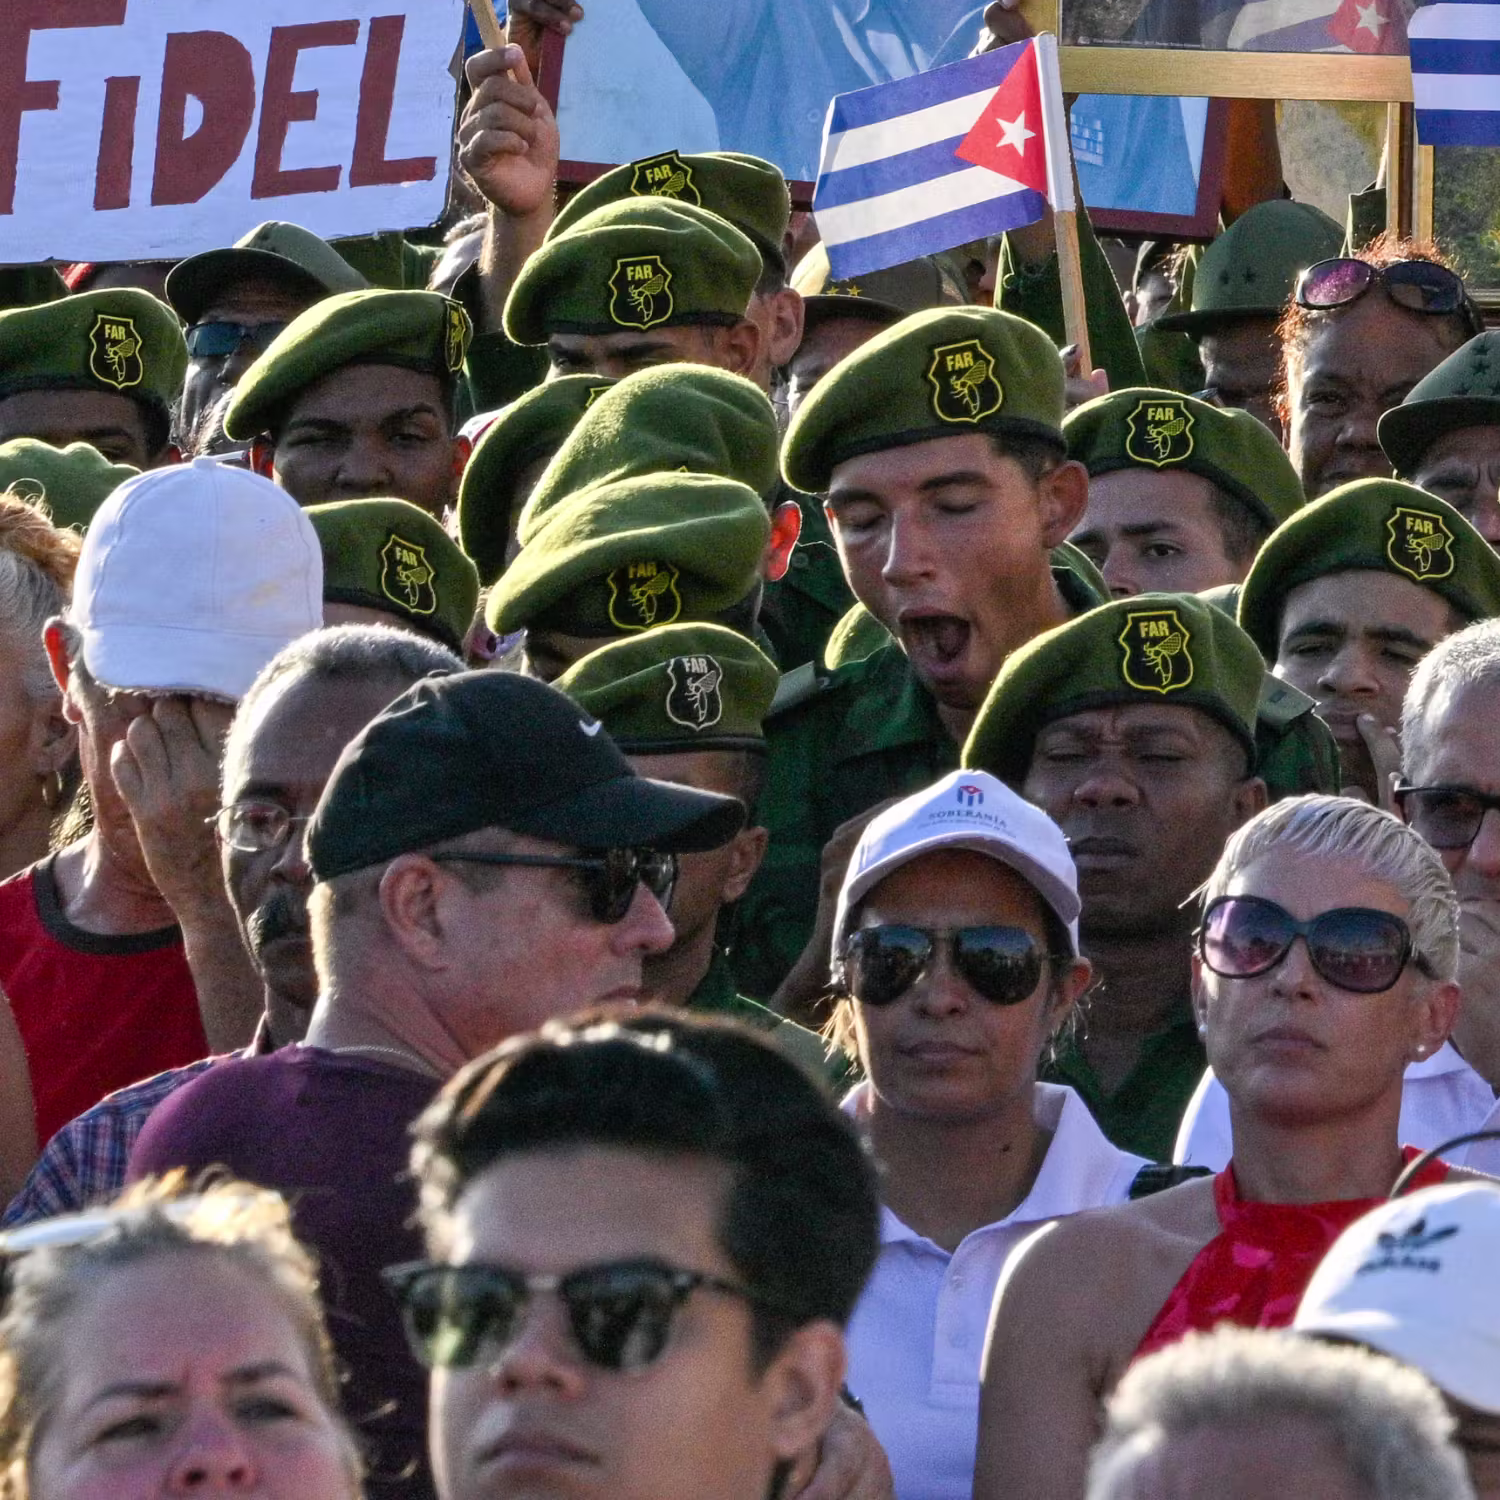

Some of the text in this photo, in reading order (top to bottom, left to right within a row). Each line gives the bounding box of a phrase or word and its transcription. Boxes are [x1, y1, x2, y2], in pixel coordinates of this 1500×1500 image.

[645, 164, 672, 183] FAR
[626, 264, 653, 281] FAR
[104, 324, 126, 340] FAR
[946, 351, 974, 372] FAR
[1147, 407, 1174, 421] FAR
[1406, 516, 1433, 534] FAR
[396, 547, 418, 567] FAR
[628, 561, 657, 578] FAR
[1140, 621, 1169, 638] FAR
[683, 657, 707, 673] FAR
